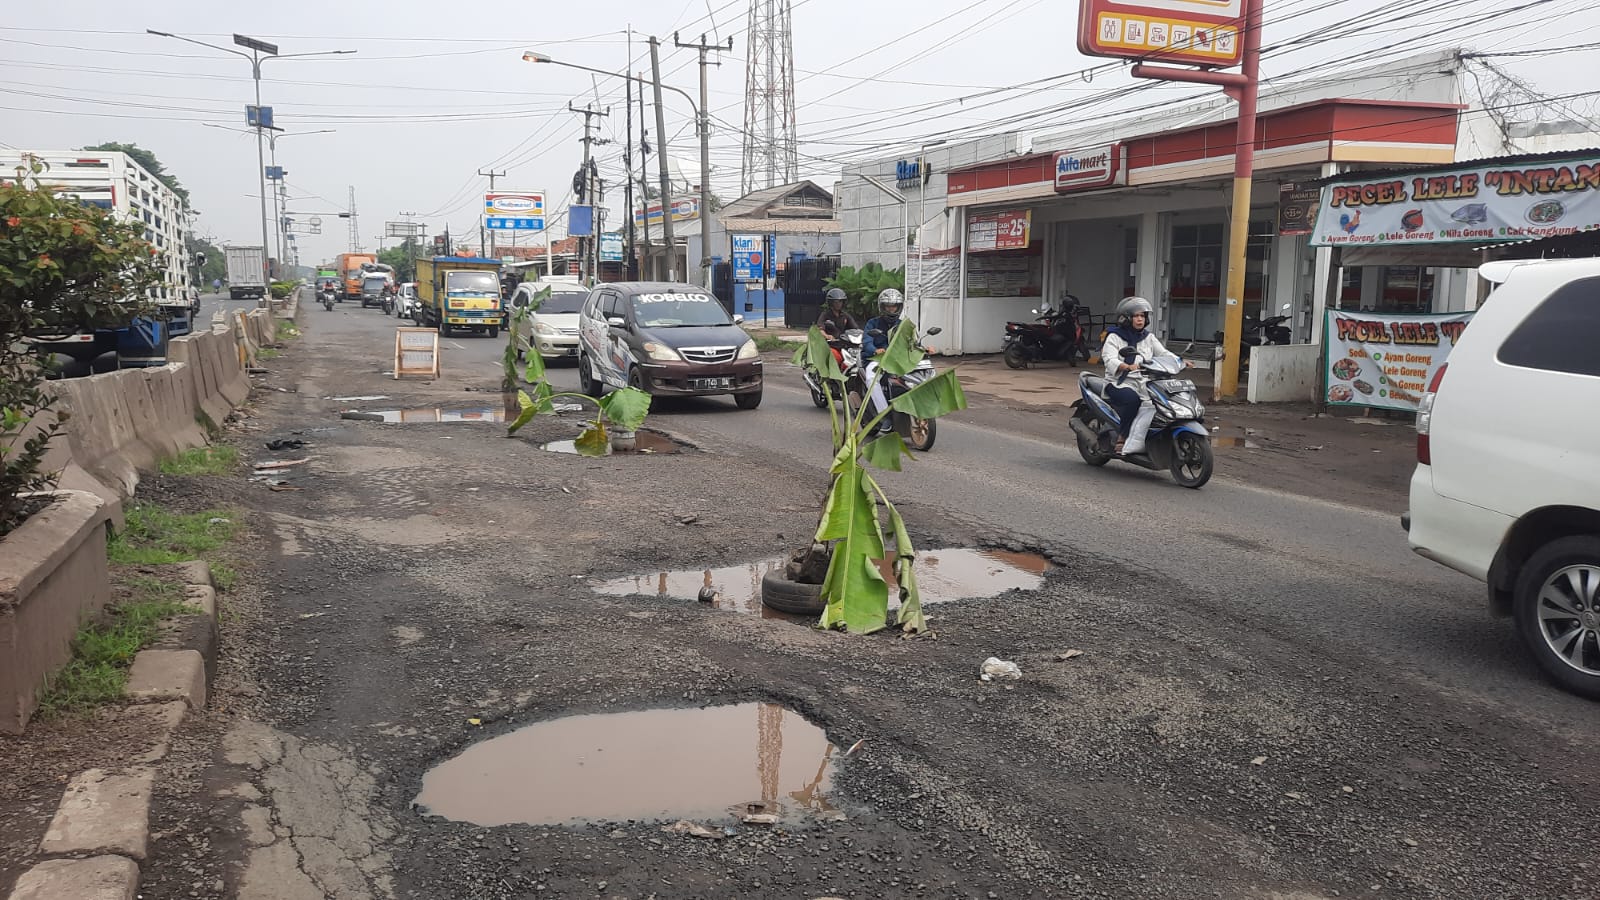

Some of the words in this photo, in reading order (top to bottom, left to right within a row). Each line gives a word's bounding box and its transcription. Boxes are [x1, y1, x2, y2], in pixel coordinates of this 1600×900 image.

[1059, 152, 1107, 172] Alfamart
[1331, 180, 1406, 208] PECEL
[1412, 172, 1479, 201] LELE
[1010, 219, 1030, 236] 25%
[1463, 229, 1493, 238] Goreng
[1327, 235, 1348, 243] Ayam
[1349, 234, 1375, 243] Goreng
[1386, 232, 1402, 240] Lele
[1405, 230, 1434, 240] Goreng
[641, 293, 710, 303] KOBELCO
[1336, 317, 1391, 343] PECEL
[1390, 321, 1440, 346] LELE
[1384, 352, 1403, 362] Ayam
[1405, 352, 1431, 366] Goreng
[1384, 365, 1399, 375] Lele
[1400, 366, 1427, 379] Goreng
[1398, 380, 1425, 393] Goreng
